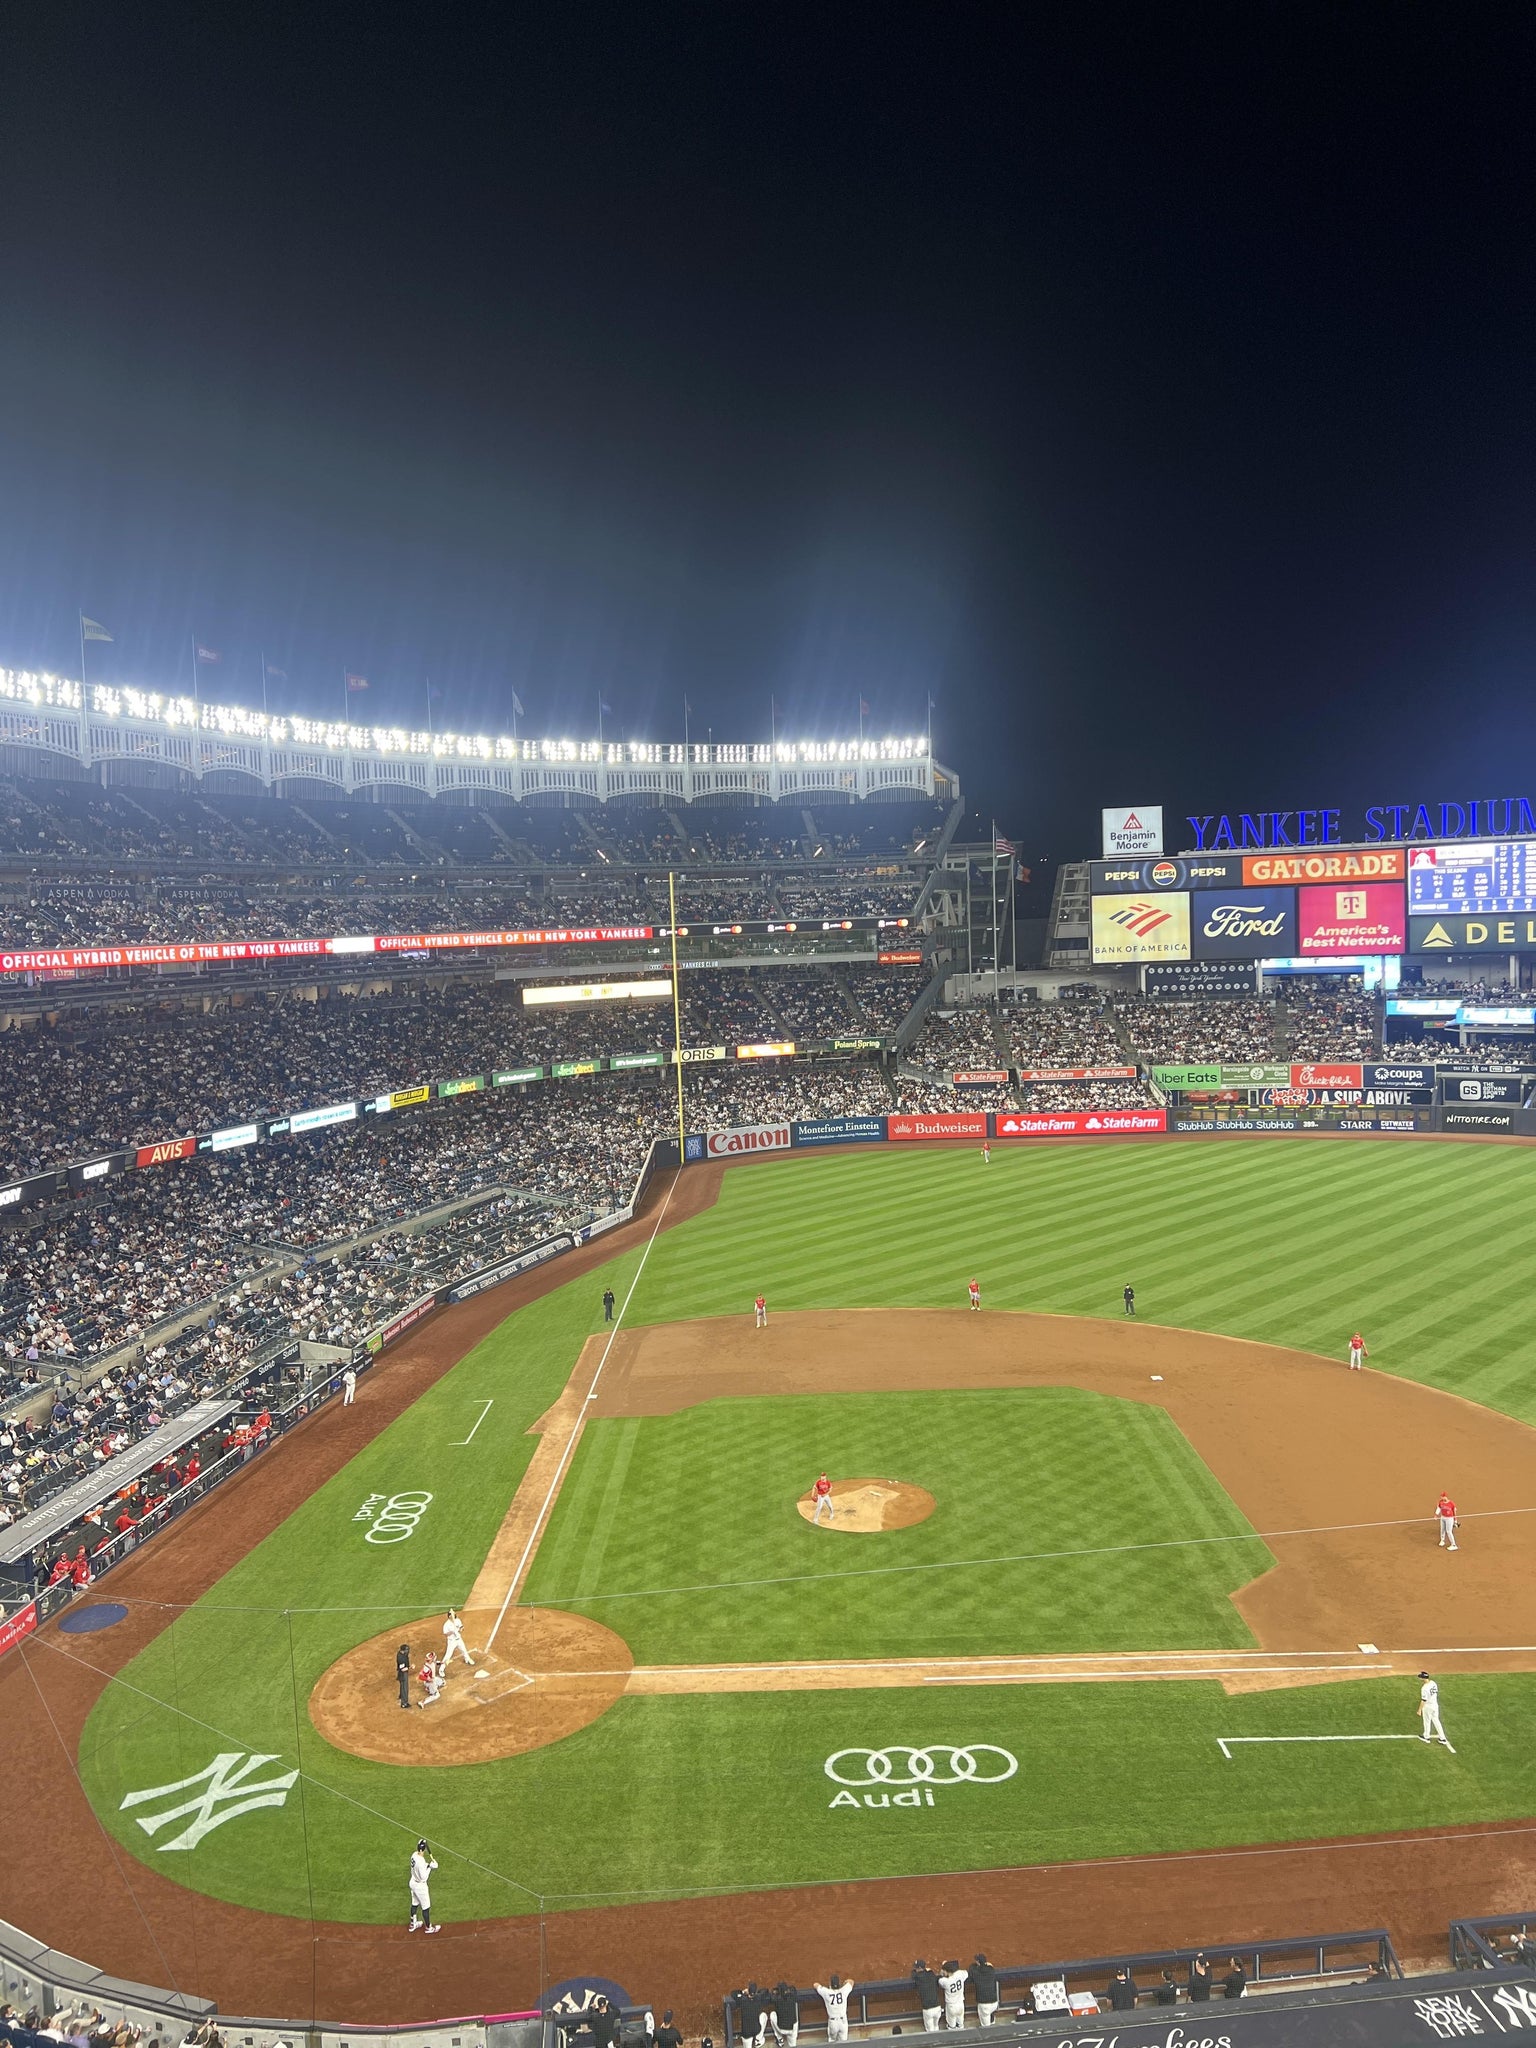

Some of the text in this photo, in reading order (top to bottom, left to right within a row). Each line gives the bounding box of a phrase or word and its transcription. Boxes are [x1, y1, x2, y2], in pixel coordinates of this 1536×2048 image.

[1110, 831, 1156, 842] Benjamin
[1186, 808, 1342, 851] YANKEE
[1116, 840, 1149, 850] Moore
[1153, 869, 1176, 878] PEPSI
[1190, 866, 1226, 878] PEPSI
[1251, 854, 1397, 880] GATORADE
[1105, 871, 1140, 882] PEPSI
[1203, 905, 1286, 939] Ford
[1314, 925, 1389, 936] America's
[379, 928, 646, 948] OFFICIAL HYBRID VEHICLE OF THE NEW YORK YANKEES
[1302, 934, 1402, 948] Best Network
[3, 941, 320, 970] OFFICIAL HYBRID VEHICLE OF THE NEW YORK YANKEES
[1094, 943, 1188, 955] BANK OF AMERICA
[834, 1040, 880, 1050] Poland Spring
[681, 1049, 715, 1061] ORIS
[1187, 1073, 1217, 1084] Eats
[1389, 1069, 1423, 1080] coupa
[1463, 1086, 1478, 1094] GS
[1321, 1091, 1330, 1104] A
[1366, 1091, 1413, 1105] ABOVE
[1177, 1123, 1213, 1131] StubHub
[1216, 1122, 1252, 1130] StubHub
[1256, 1120, 1294, 1130] StubHub
[1340, 1121, 1372, 1129] STARR
[1446, 1115, 1510, 1126] NITTOTIRE.COM
[798, 1121, 879, 1135] Montefiore Einstein
[915, 1122, 982, 1134] Budweiser
[708, 1128, 789, 1154] Canon
[150, 1142, 183, 1163] AVIS
[282, 1345, 299, 1360] StubHub
[258, 1360, 276, 1376] StubHub
[231, 1378, 250, 1394] StubHub
[73, 1469, 113, 1497] Yankee
[22, 1494, 80, 1529] Stadium
[352, 1493, 384, 1522] Audi
[2, 1622, 26, 1644] AMERICA
[829, 1788, 935, 1808] Audi
[950, 1980, 963, 1994] 28
[828, 1992, 844, 2006] 78
[1413, 1994, 1464, 2014] NEW
[1414, 2005, 1482, 2026] YORK
[1434, 2019, 1485, 2039] LIFE
